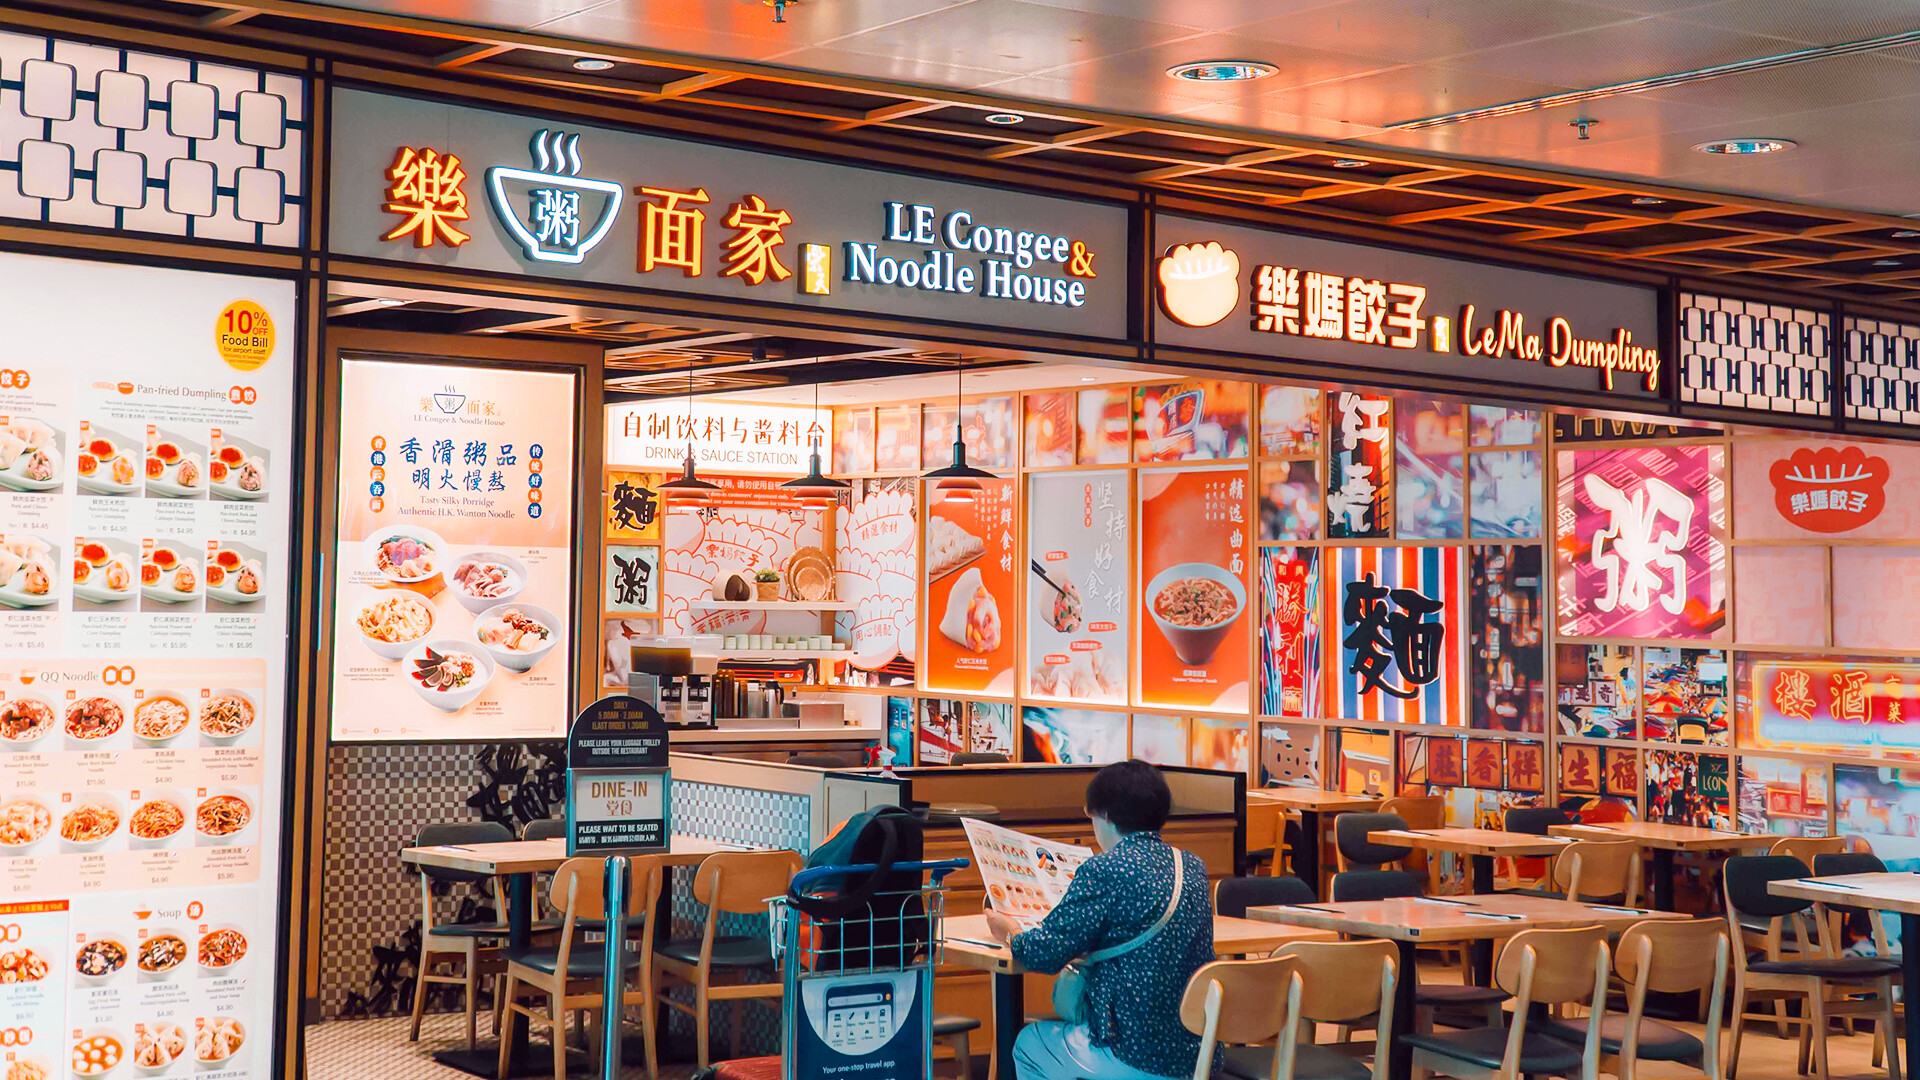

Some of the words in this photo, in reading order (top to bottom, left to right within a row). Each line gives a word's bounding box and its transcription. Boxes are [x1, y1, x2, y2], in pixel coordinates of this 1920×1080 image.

[884, 202, 935, 244] LE
[942, 211, 1069, 269] Congee
[1065, 240, 1096, 278] &
[843, 242, 975, 293] Noodle
[981, 259, 1085, 307] House
[1251, 264, 1427, 349] 樂媽餃子
[222, 335, 248, 346] Food
[252, 337, 268, 348] Bill
[1459, 304, 1543, 361] LeMa
[1544, 317, 1660, 391] Dumpling
[137, 384, 179, 396] Pan-fried
[182, 387, 227, 402] Dumpling
[424, 415, 450, 424] Congee
[460, 416, 483, 425] Noodle
[484, 418, 506, 426] House
[624, 411, 825, 448] 自制饮料与酱料台
[400, 437, 517, 466] 香滑粥品
[645, 446, 684, 460] DRINK
[701, 449, 744, 463] SAUCE
[747, 451, 798, 465] STATION
[412, 467, 506, 492] 明火慢熬
[420, 496, 440, 505] Tasty
[441, 496, 460, 507] Silky
[462, 497, 495, 508] Porridge
[1790, 490, 1868, 515] 樂媽餃子
[398, 506, 436, 516] Authentic
[456, 508, 487, 518] Wanton
[488, 510, 516, 519] Noodle
[1583, 473, 1695, 615] 粥
[612, 553, 651, 605] 粥
[40, 671, 59, 683] QQ
[62, 671, 99, 681] Noodle
[608, 722, 626, 730] ORDER
[592, 781, 648, 798] DINE-IN
[578, 826, 601, 834] PLEASE
[602, 825, 618, 833] WAIT
[618, 824, 626, 832] TO
[628, 824, 636, 832] BE
[636, 824, 659, 832] SEATED
[157, 909, 182, 920] Soup
[822, 1066, 836, 1074] Your
[838, 1064, 864, 1072] one-stop
[866, 1060, 882, 1069] travel
[883, 1060, 896, 1068] app
